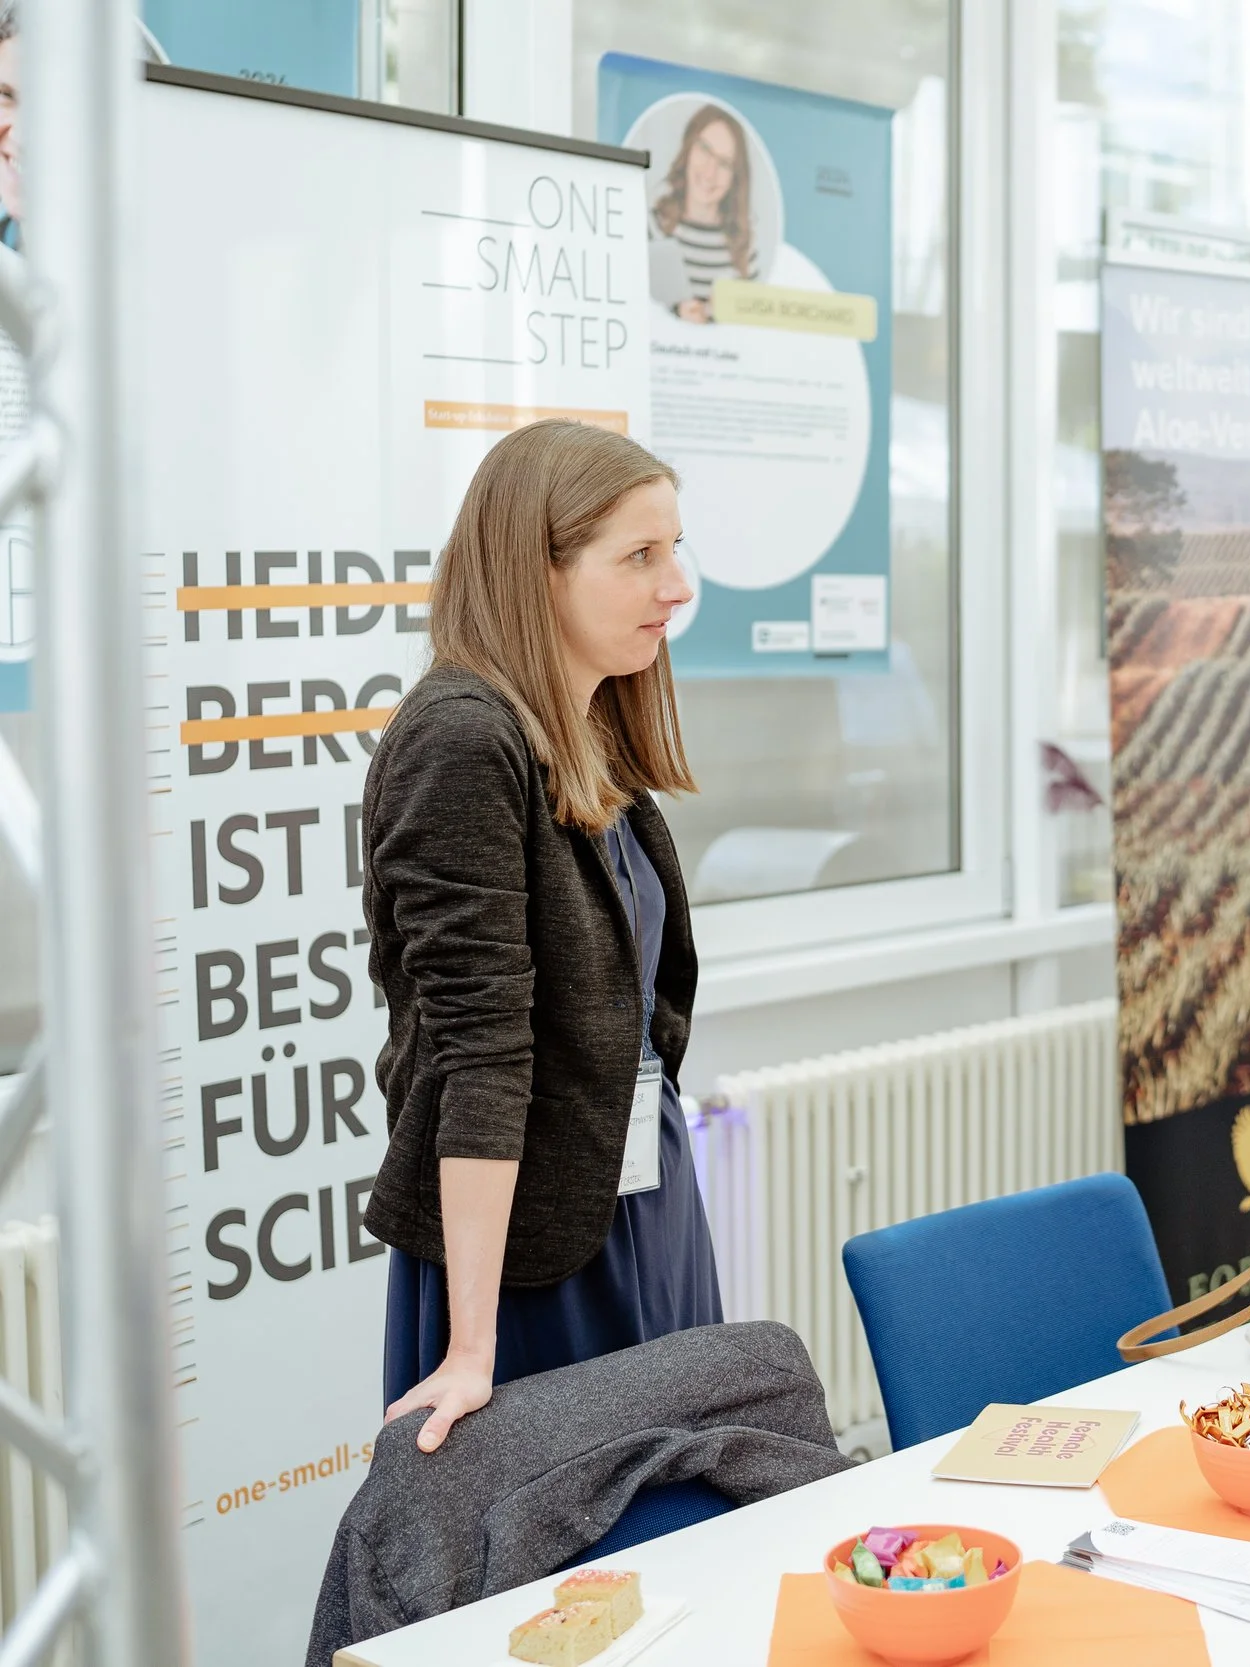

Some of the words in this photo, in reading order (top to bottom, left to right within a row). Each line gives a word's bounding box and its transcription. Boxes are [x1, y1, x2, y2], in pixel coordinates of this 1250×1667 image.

[528, 175, 624, 239] ONE
[477, 235, 626, 304] SMALL
[526, 310, 628, 369] STEP
[1130, 294, 1182, 334] Wir
[1190, 302, 1250, 339] sind
[190, 807, 320, 910] IST
[200, 1041, 370, 1173] FÜR
[994, 1416, 1042, 1457] Festival
[1026, 1421, 1071, 1456] Health
[1055, 1420, 1101, 1460] Female
